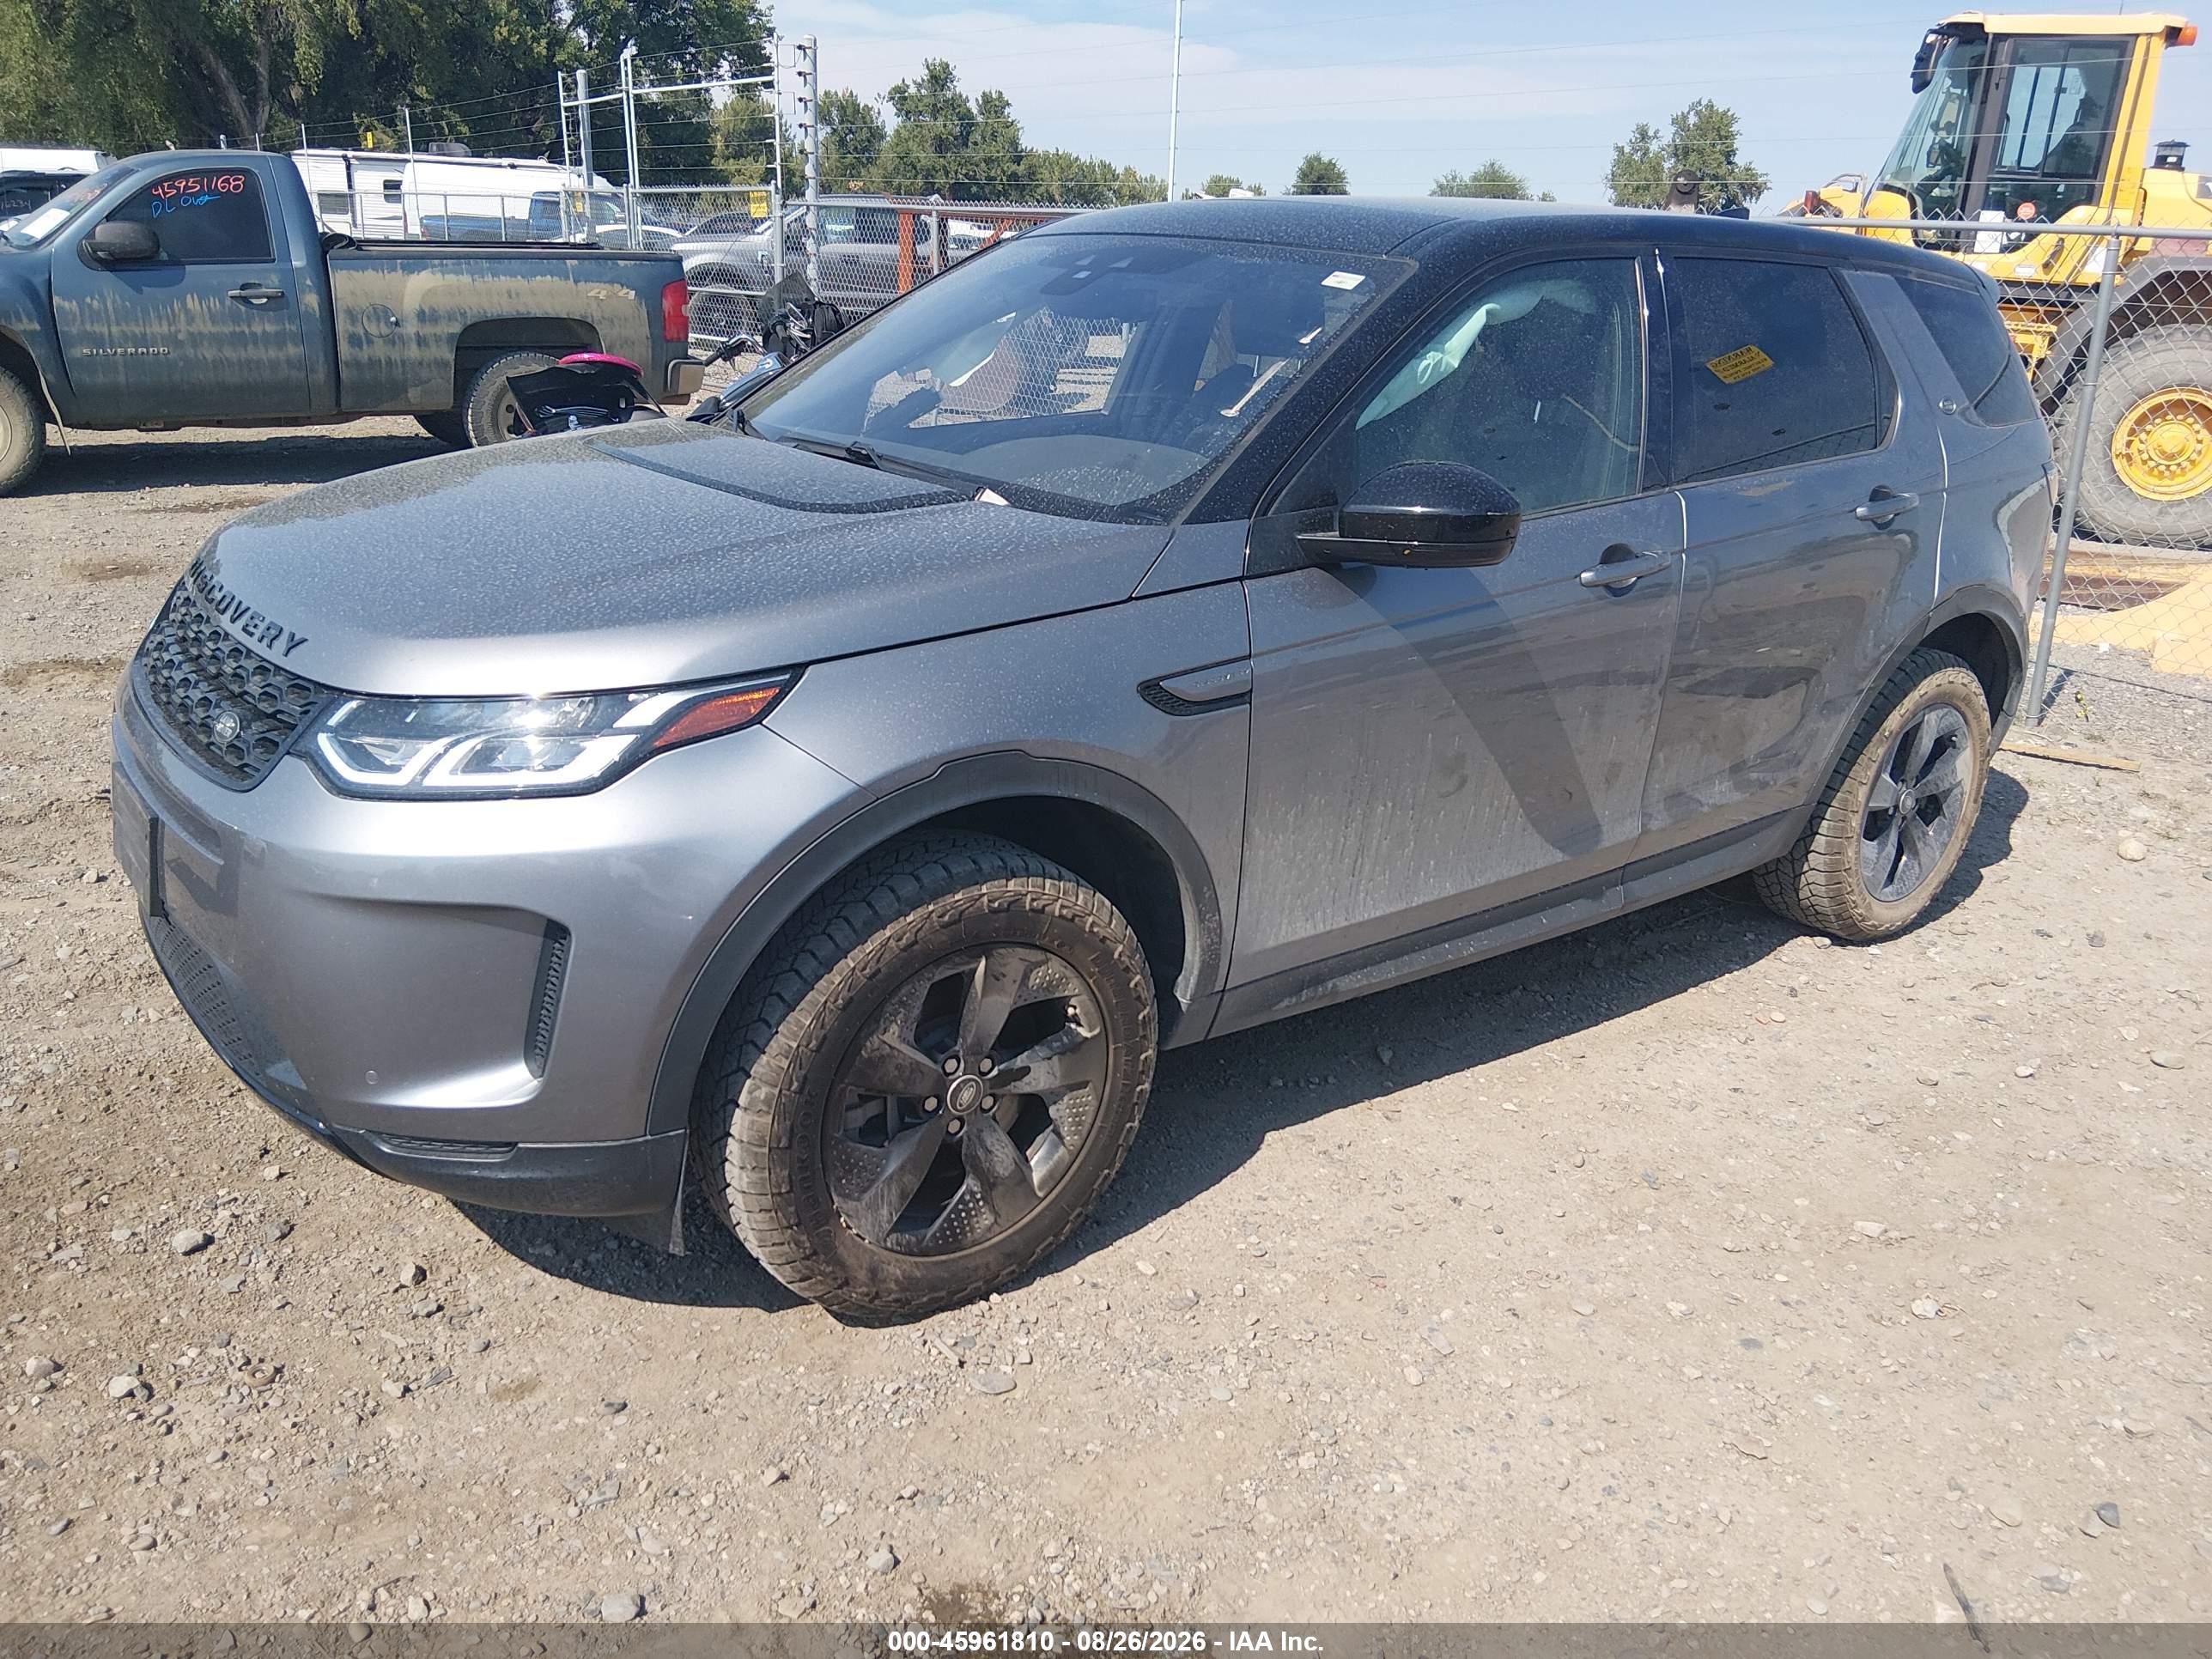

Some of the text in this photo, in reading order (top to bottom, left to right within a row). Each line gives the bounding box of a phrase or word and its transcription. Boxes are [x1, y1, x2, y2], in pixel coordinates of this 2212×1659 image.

[152, 175, 245, 199] 45951168
[82, 347, 170, 357] SILVERADO
[189, 558, 309, 658] DISCOVERY
